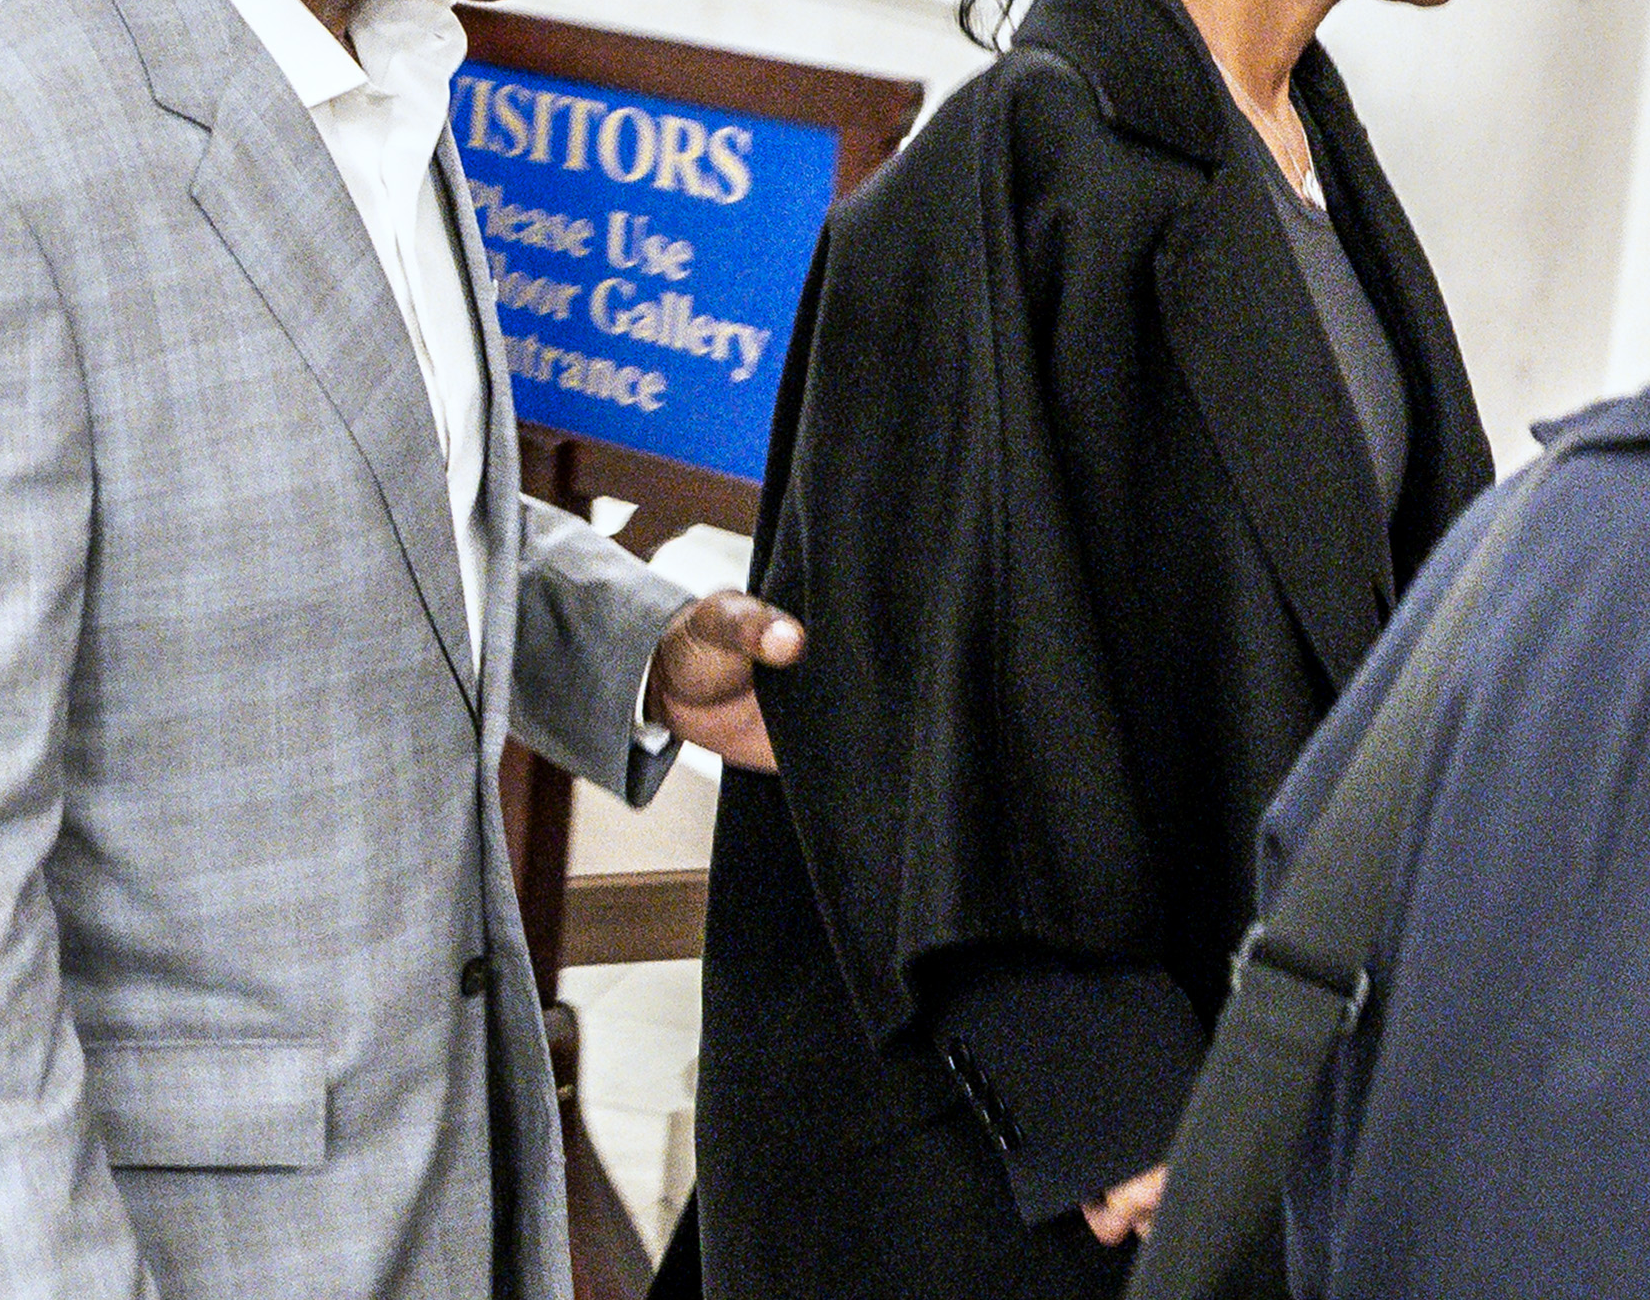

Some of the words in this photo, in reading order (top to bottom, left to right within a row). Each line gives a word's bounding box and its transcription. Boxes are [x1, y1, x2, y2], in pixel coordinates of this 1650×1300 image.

[607, 211, 694, 281] Use
[486, 247, 581, 320] loor
[590, 277, 771, 382] Gallery
[503, 335, 666, 412] ntrance
